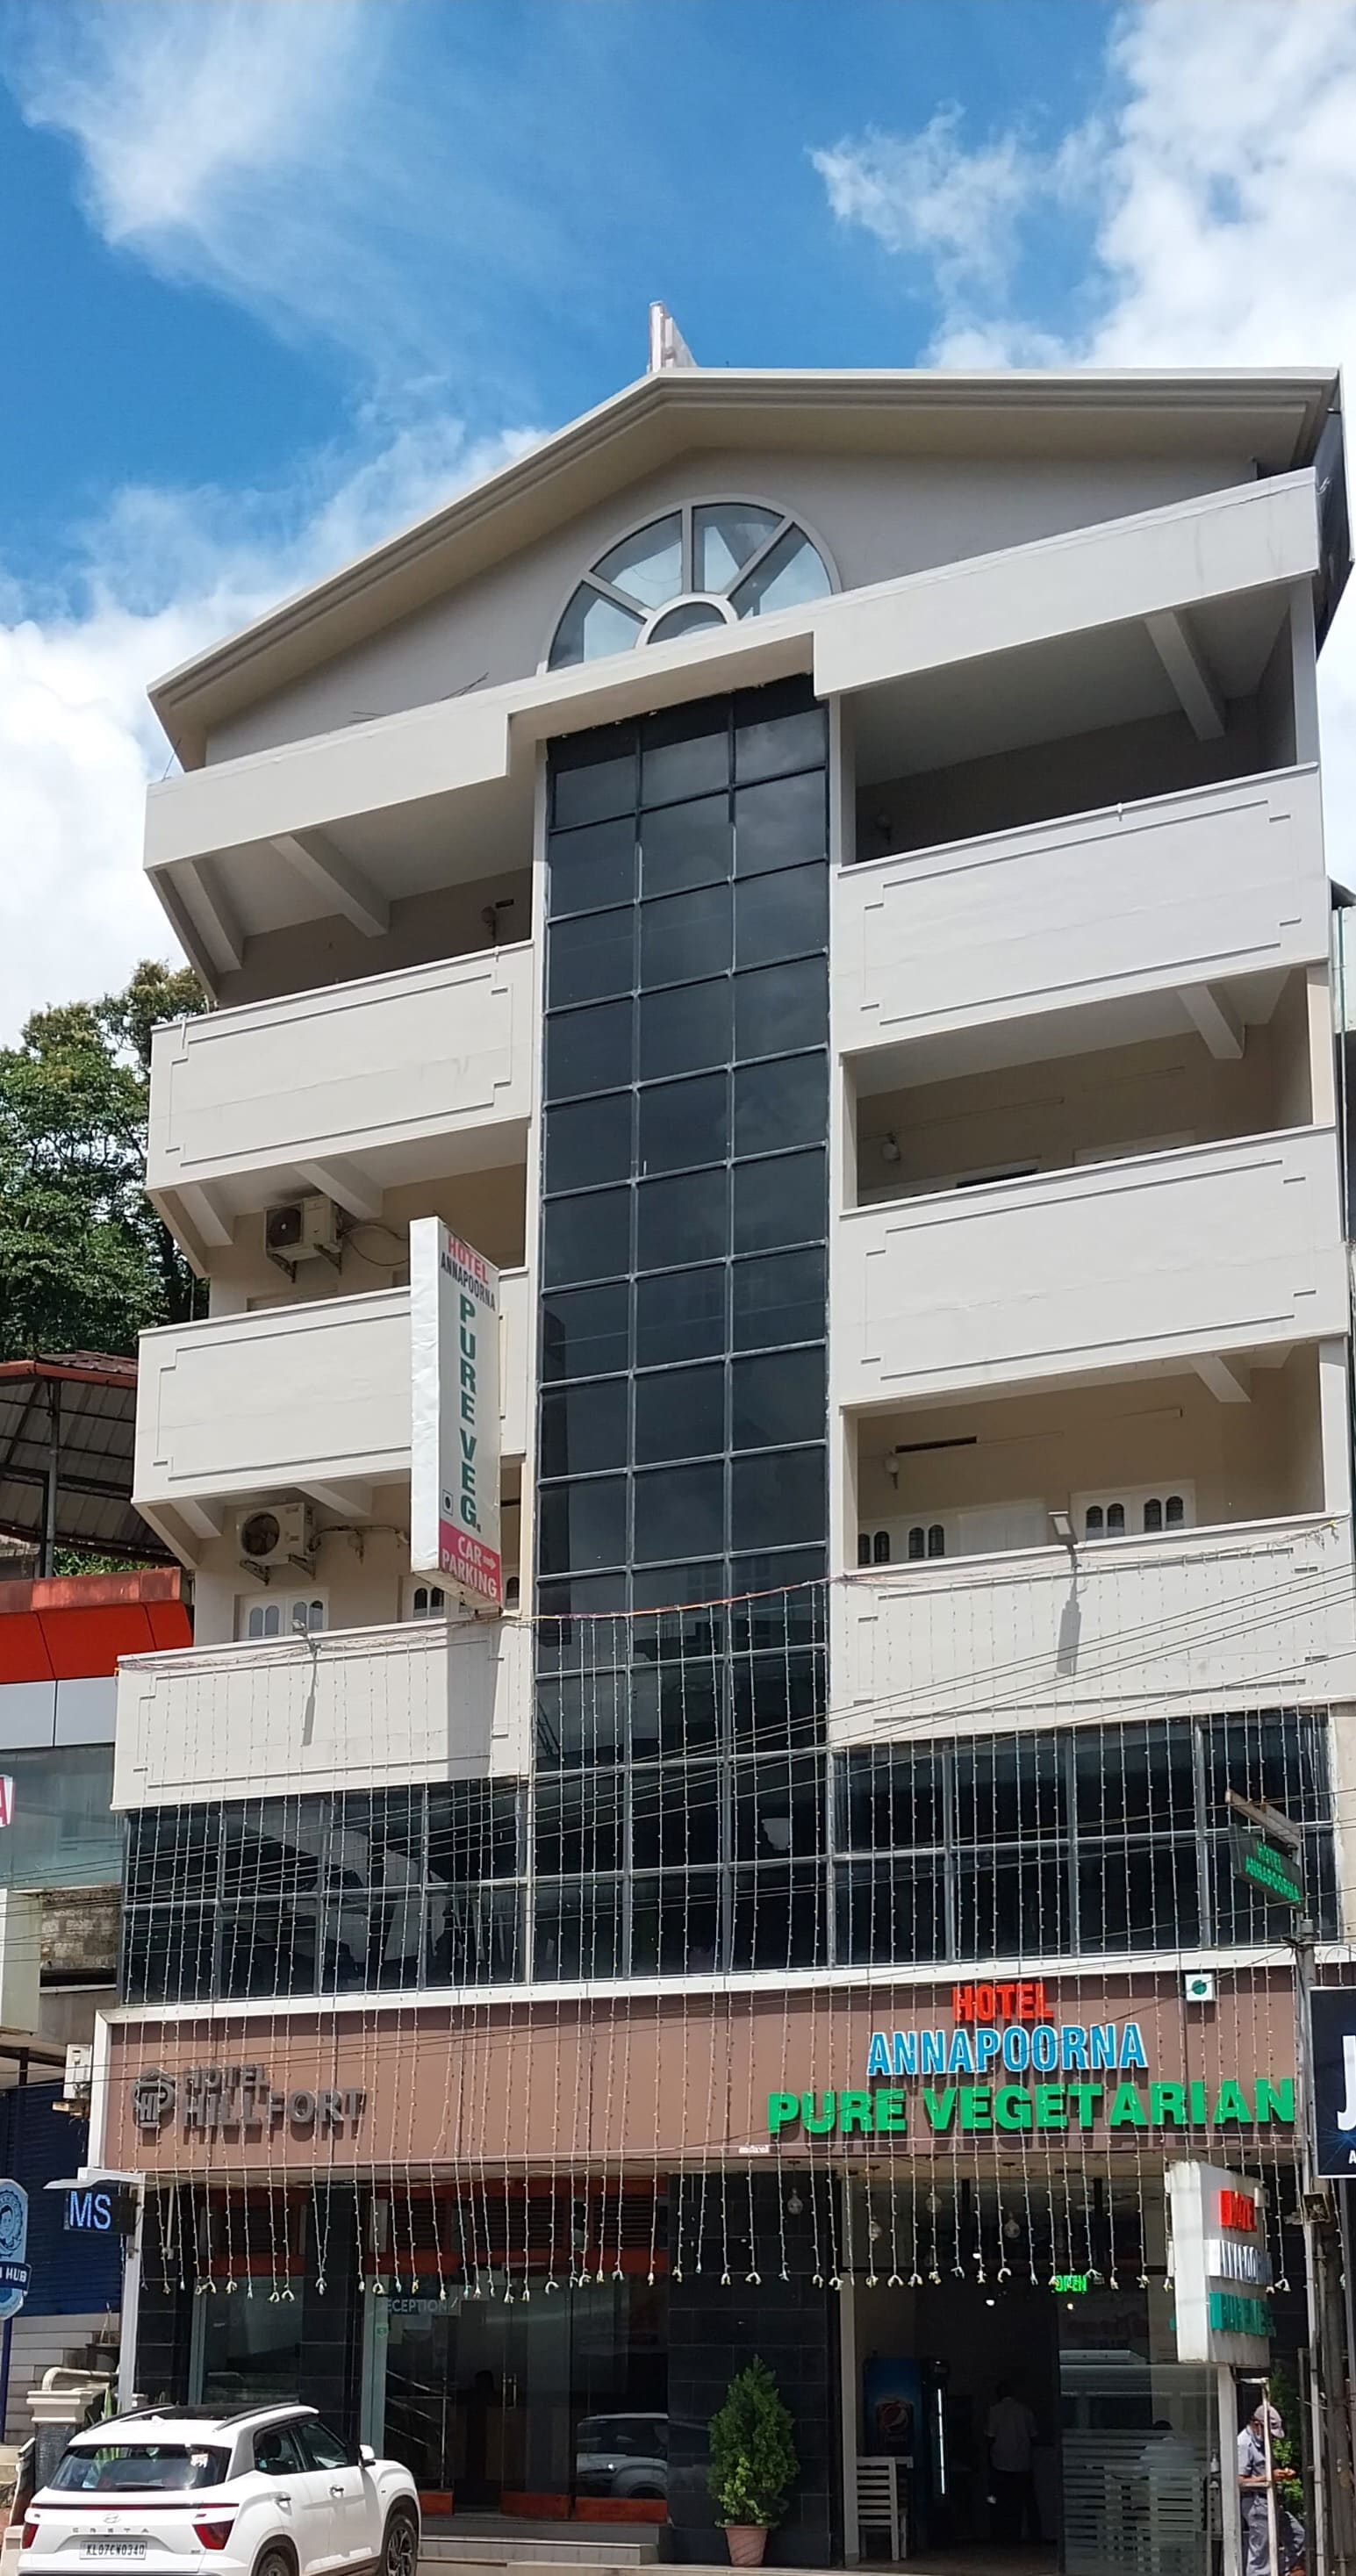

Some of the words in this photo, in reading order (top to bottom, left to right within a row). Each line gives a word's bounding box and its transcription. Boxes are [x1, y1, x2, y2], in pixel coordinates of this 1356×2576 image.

[448, 1234, 489, 1285] HOTEL
[441, 1252, 496, 1312] ANNAPOORNA
[459, 1293, 477, 1424] PURE
[458, 1536, 482, 1567] CAR
[441, 1548, 497, 1597] PARKING
[951, 1982, 1054, 2021] HOTEL
[866, 2022, 1150, 2076] ANNAPOORNA
[183, 2064, 271, 2089] HOTEL
[768, 2087, 909, 2135] PURE
[922, 2077, 1295, 2130] VEGETARIAN
[69, 2191, 111, 2230] MS
[5, 2266, 28, 2283] HUB
[1054, 2274, 1087, 2293] OPEN
[386, 2298, 448, 2314] ECEPTION
